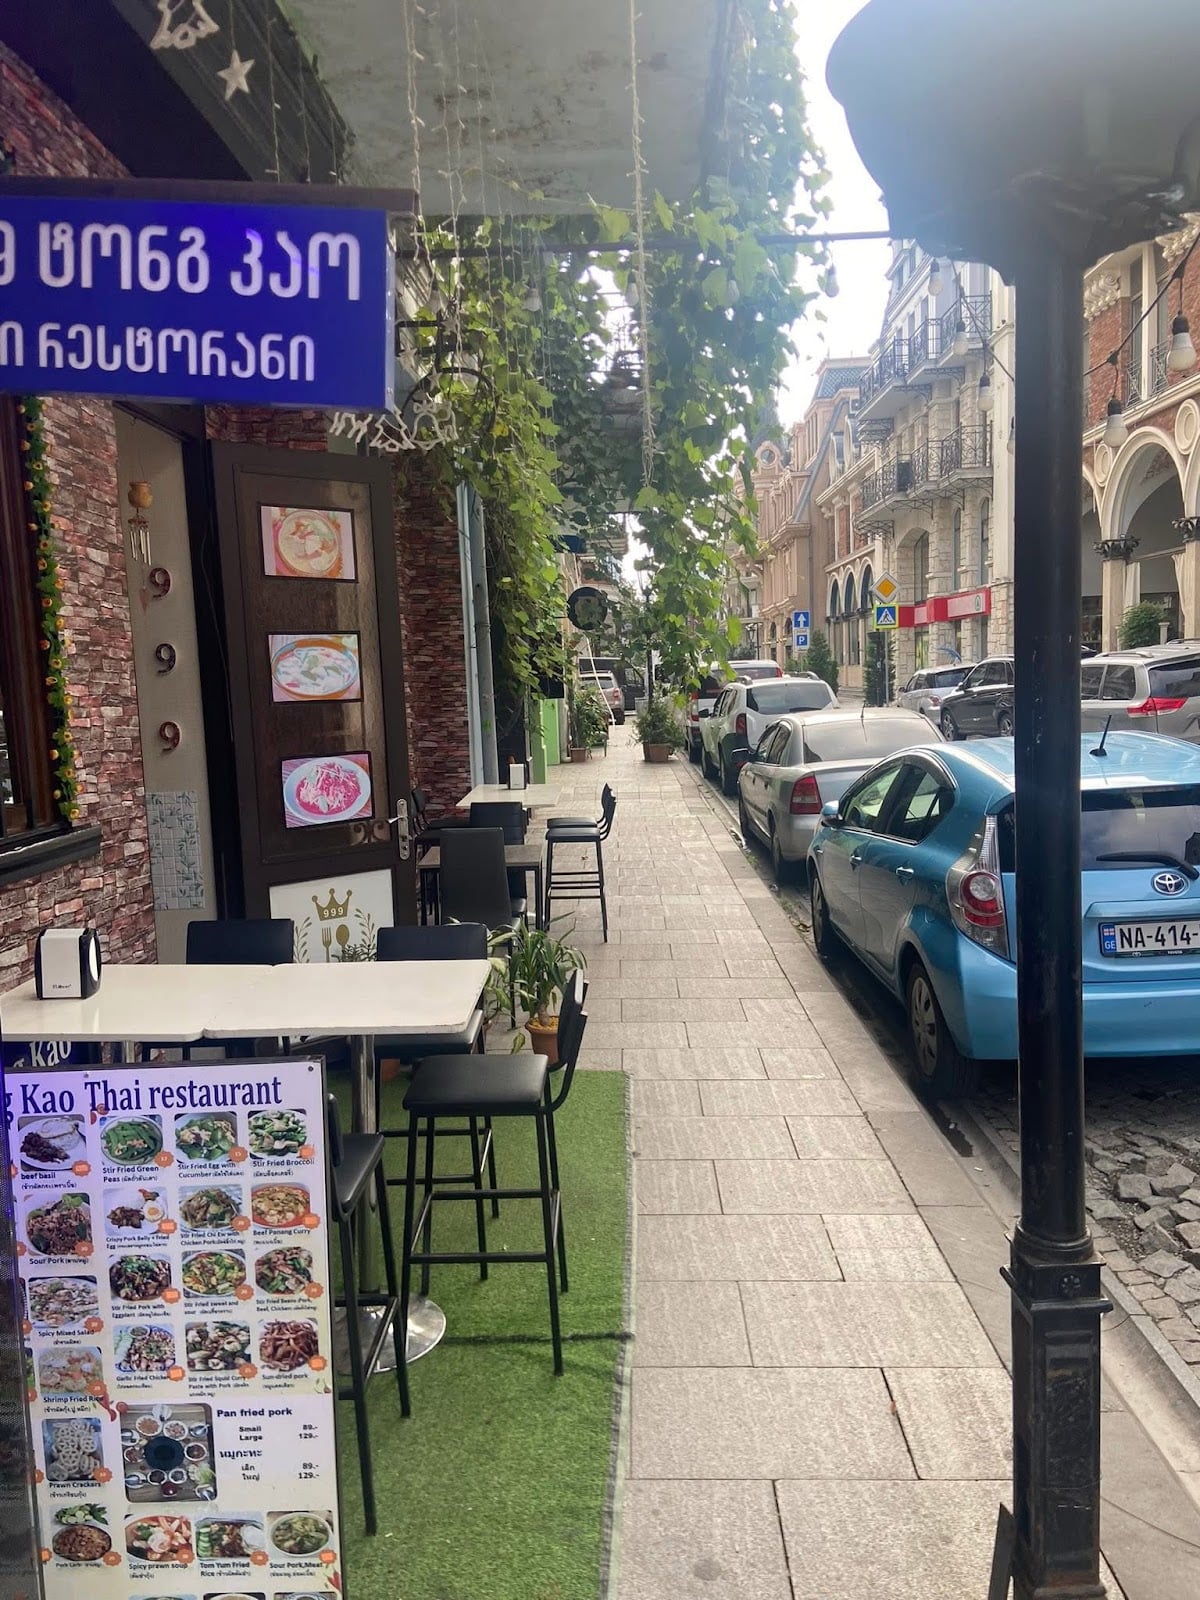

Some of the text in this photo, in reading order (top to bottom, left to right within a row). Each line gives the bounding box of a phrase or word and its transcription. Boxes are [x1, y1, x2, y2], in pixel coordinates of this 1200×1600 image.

[39, 221, 210, 294] ტონგ
[230, 227, 360, 300] კაო
[38, 322, 315, 382] რესტორანი
[150, 567, 171, 598] 9
[155, 643, 177, 674] 9
[159, 721, 181, 752] 9
[323, 907, 344, 918] 999
[1104, 941, 1116, 950] GE
[1119, 924, 1200, 949] NA-414-
[29, 1041, 72, 1067] Kao
[20, 1084, 74, 1114] Kao
[84, 1079, 142, 1112] Thai
[149, 1076, 282, 1109] restaurant
[286, 1158, 314, 1166] Broccoli
[43, 1396, 68, 1404] Shrimp
[217, 1407, 293, 1418] Pan fried pork
